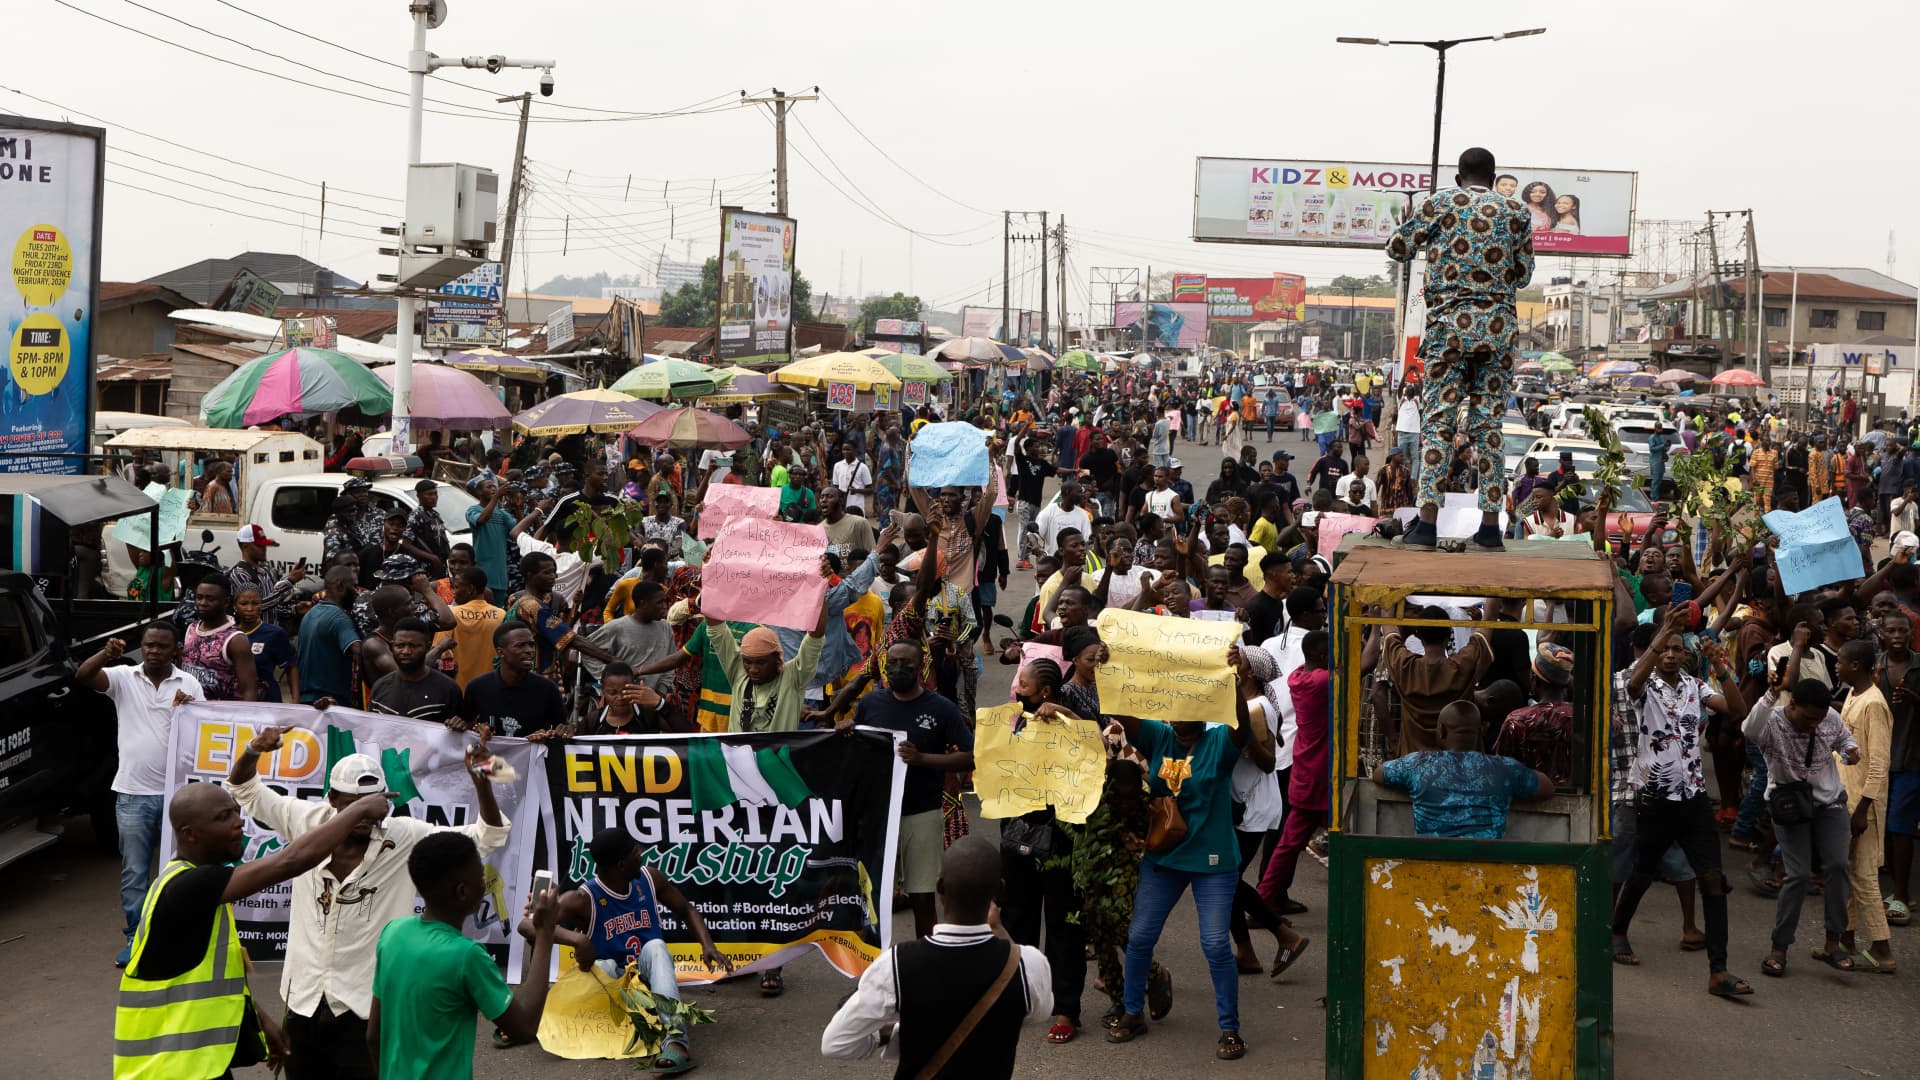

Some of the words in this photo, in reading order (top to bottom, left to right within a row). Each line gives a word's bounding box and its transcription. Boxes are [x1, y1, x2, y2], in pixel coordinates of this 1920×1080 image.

[1251, 167, 1321, 185] KIDZ
[1329, 170, 1347, 185] &
[1353, 171, 1432, 189] MORE
[36, 231, 54, 240] DATE:
[29, 243, 43, 251] TUES
[25, 260, 46, 268] FRIDAY
[48, 261, 63, 269] 23RD
[13, 268, 32, 276] NIGHT
[43, 270, 71, 278] EVIDENCE
[31, 332, 52, 344] TIME:
[43, 352, 64, 364] 8PM
[1843, 349, 1897, 366] wh
[21, 366, 28, 378] &
[31, 366, 57, 378] 10PM
[831, 383, 853, 405] POS
[905, 382, 925, 400] POS
[1121, 447, 1131, 457] R
[460, 610, 499, 621] LOEWE
[8, 726, 31, 752] FORCE
[564, 745, 683, 793] END
[563, 797, 844, 845] NIGERIAN
[570, 828, 812, 898] hrdship
[733, 901, 815, 916] #BorderLock
[604, 909, 652, 940] PHILA
[760, 910, 834, 932] #Insecurity
